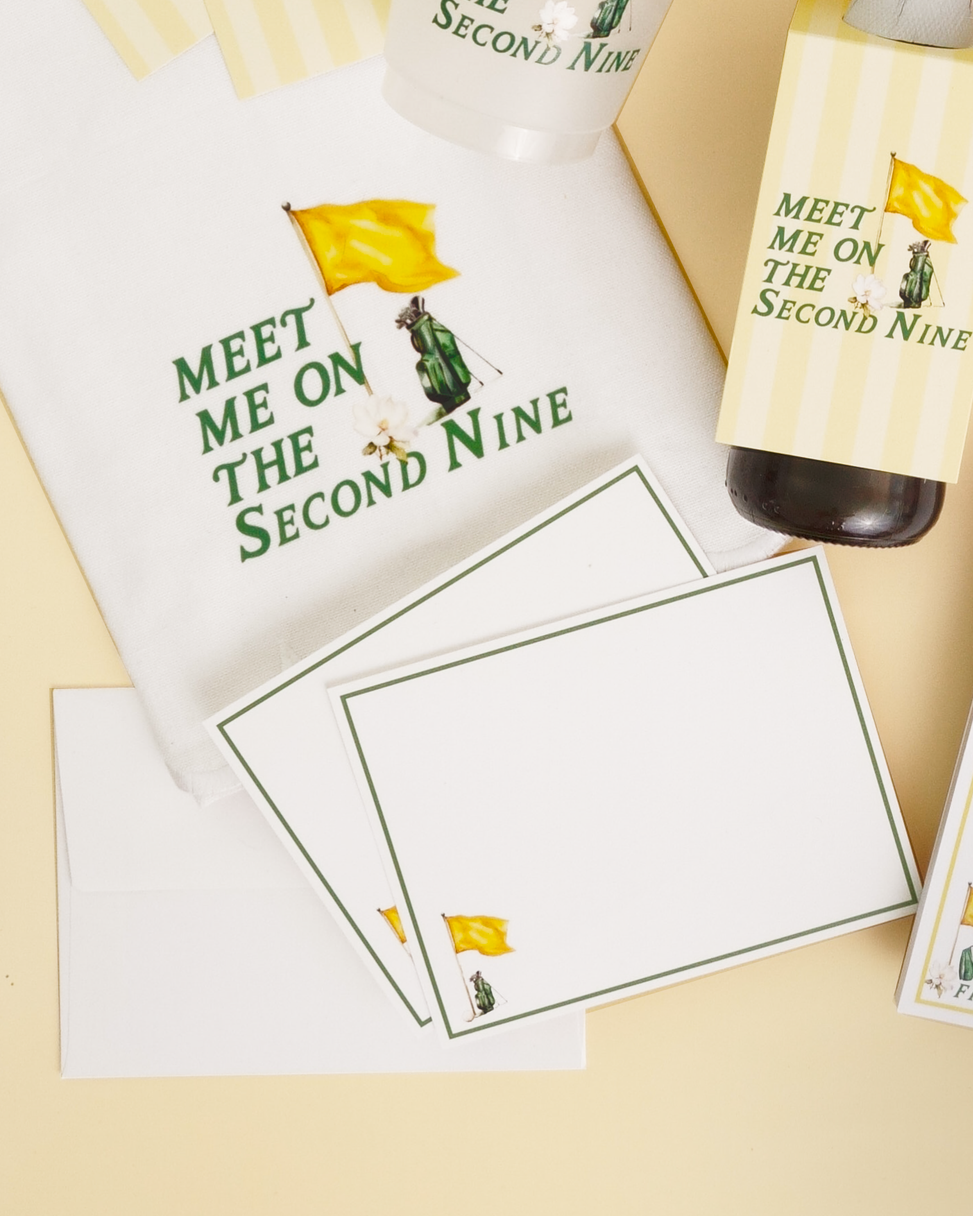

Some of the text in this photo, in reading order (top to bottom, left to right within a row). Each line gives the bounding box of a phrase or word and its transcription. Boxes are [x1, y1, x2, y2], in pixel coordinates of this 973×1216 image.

[566, 41, 640, 73] NINE
[773, 192, 876, 231] MEET
[762, 259, 832, 293] THE
[767, 226, 885, 267] ME ON
[171, 297, 315, 403] MEET
[751, 288, 973, 351] SECOND NINE
[195, 341, 367, 455] ME ON
[212, 425, 320, 507] THE
[235, 387, 574, 563] SECOND NINE
